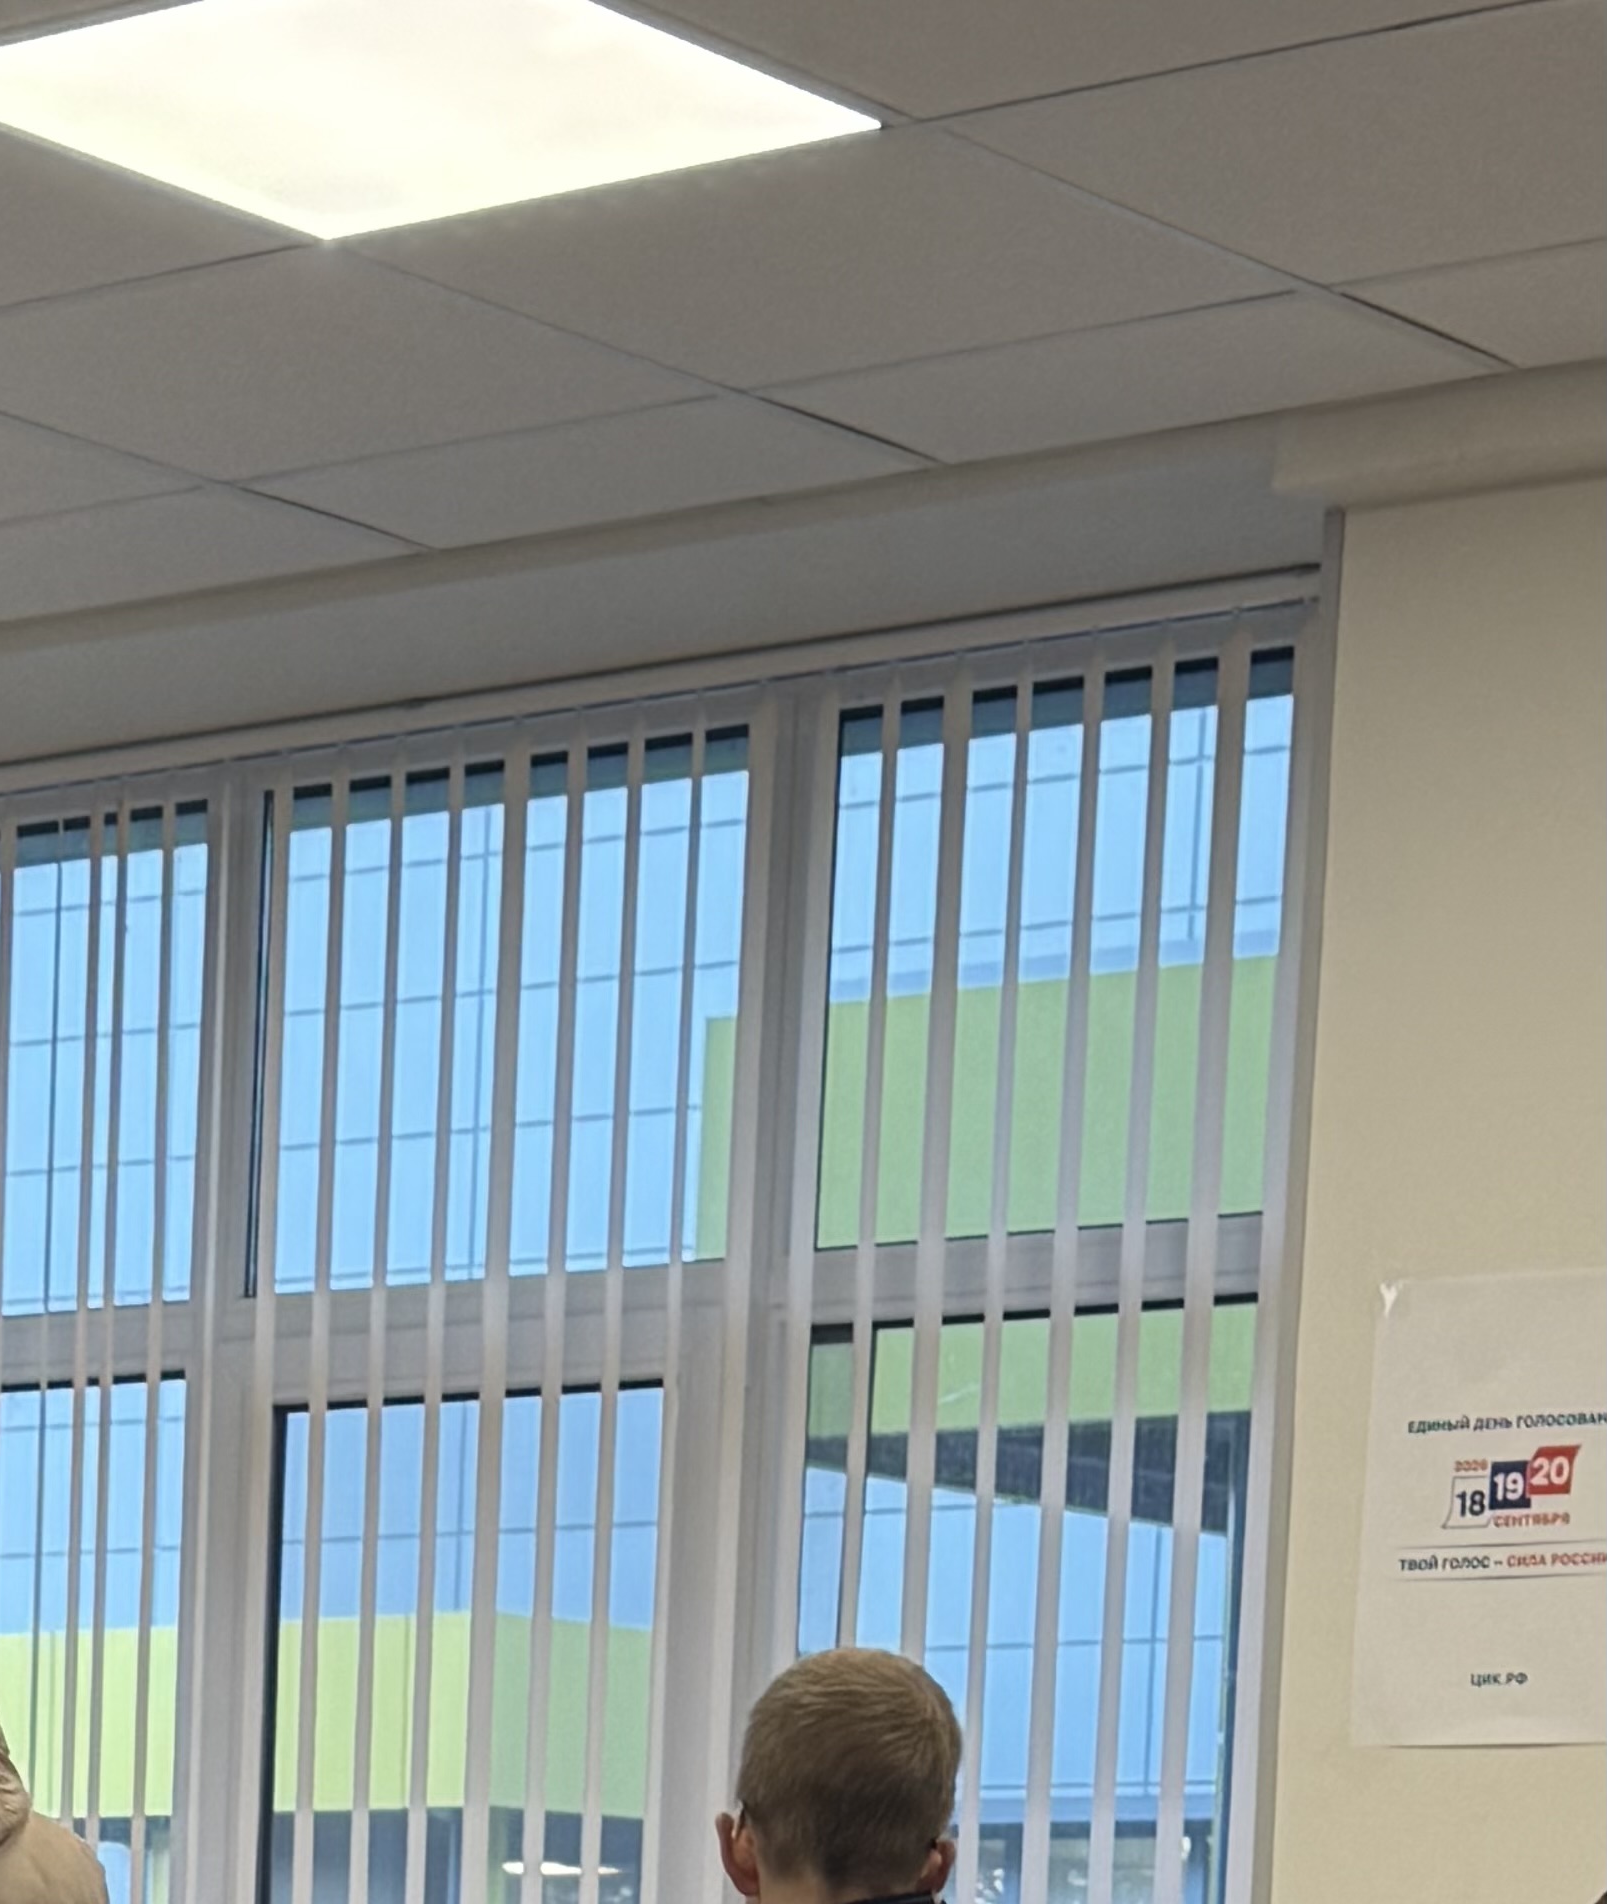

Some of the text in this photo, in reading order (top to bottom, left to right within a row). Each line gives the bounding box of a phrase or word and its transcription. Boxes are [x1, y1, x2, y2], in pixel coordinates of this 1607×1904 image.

[1408, 1415, 1470, 1434] ЕДИНЫЙ
[1473, 1416, 1513, 1432] ДЕНЬ
[1456, 1455, 1570, 1517] 18 19 20
[1399, 1555, 1438, 1571] ТВОЙ
[1442, 1556, 1491, 1570] ГОЛОС
